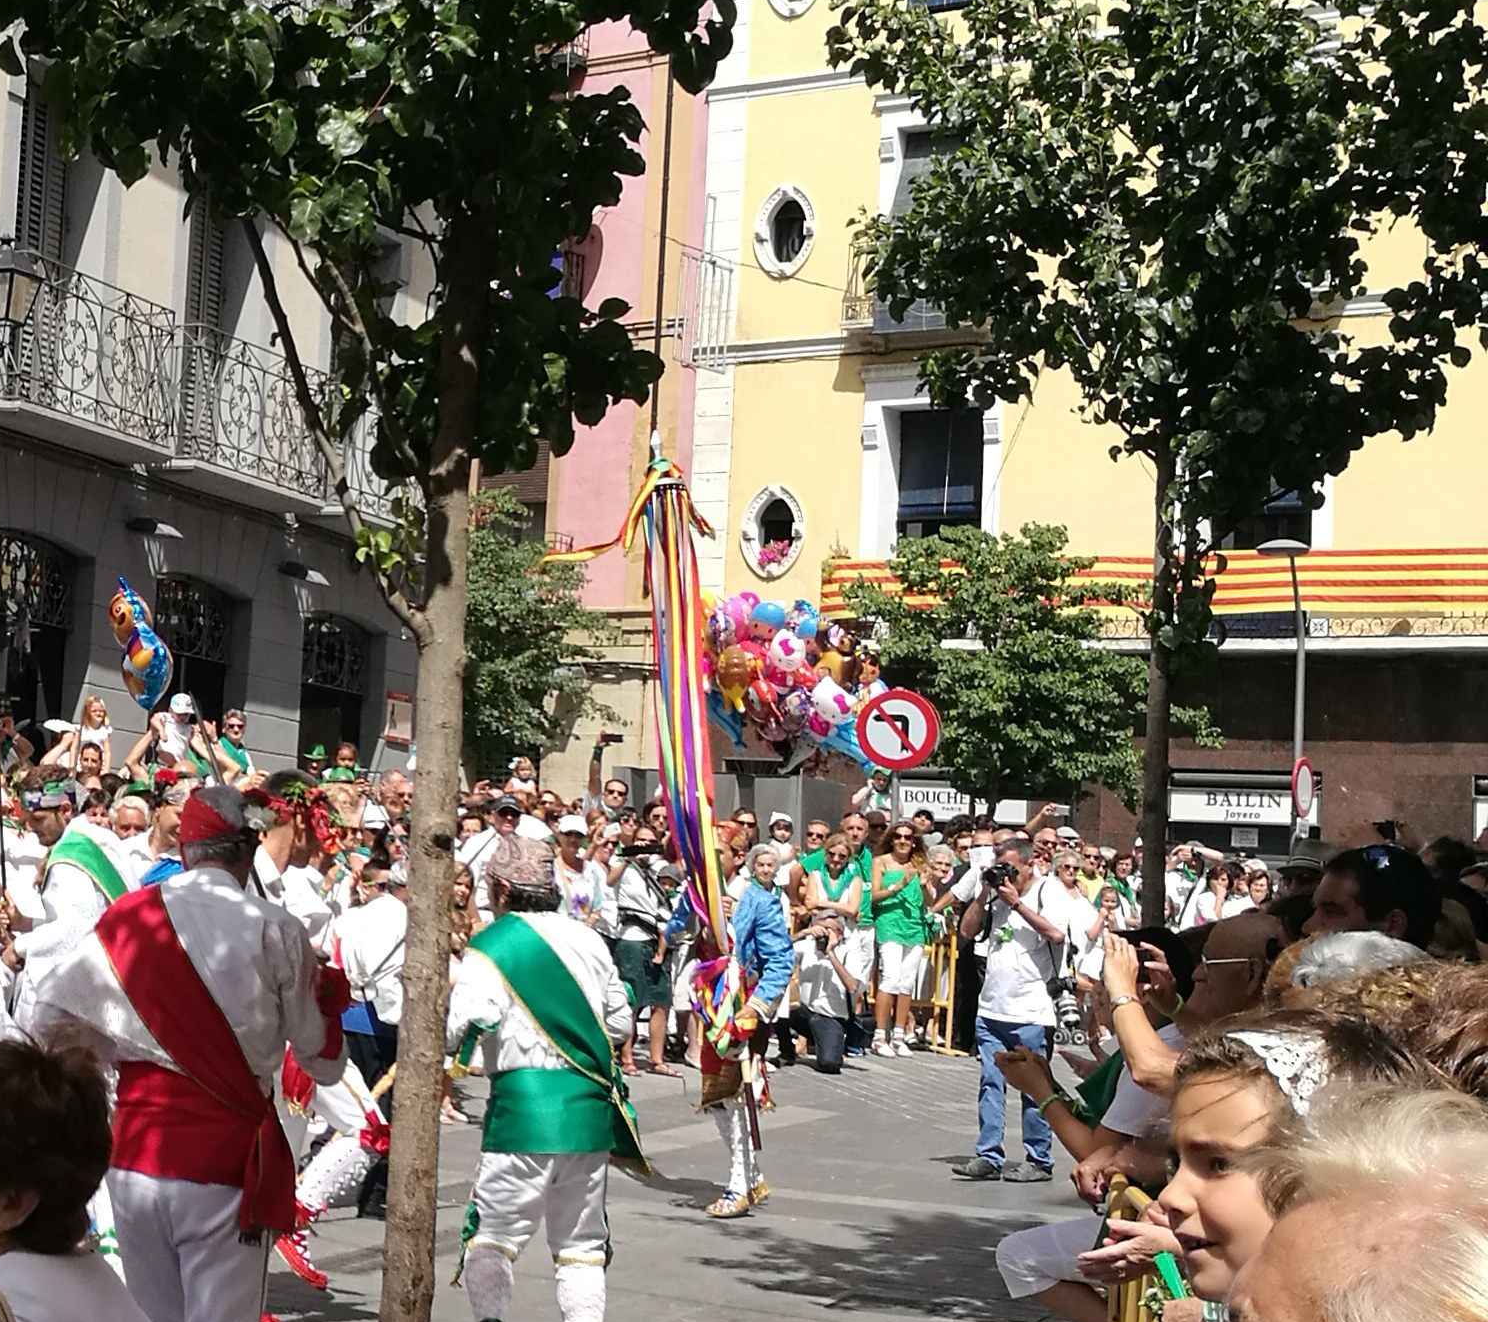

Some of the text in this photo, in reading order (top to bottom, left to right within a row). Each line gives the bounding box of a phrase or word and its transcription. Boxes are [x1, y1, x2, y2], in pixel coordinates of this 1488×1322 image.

[904, 789, 988, 806] BOUCHE
[1205, 792, 1283, 809] BAILIN
[1223, 809, 1261, 822] Joyero
